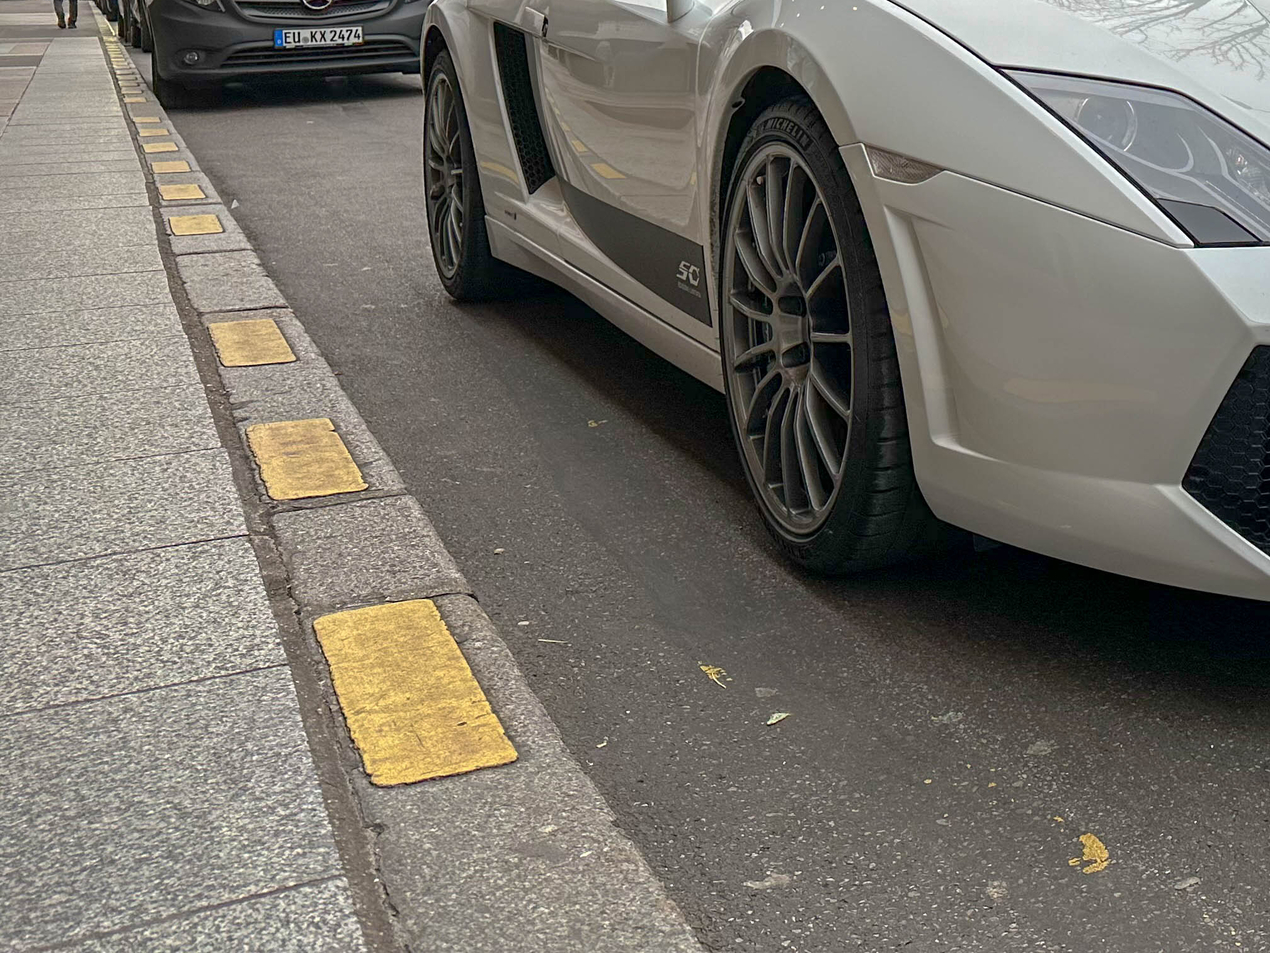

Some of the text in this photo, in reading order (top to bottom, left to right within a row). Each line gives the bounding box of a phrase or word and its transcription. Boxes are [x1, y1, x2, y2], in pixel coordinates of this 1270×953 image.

[284, 29, 361, 44] EU KX 2474
[766, 118, 810, 147] MICHELIN
